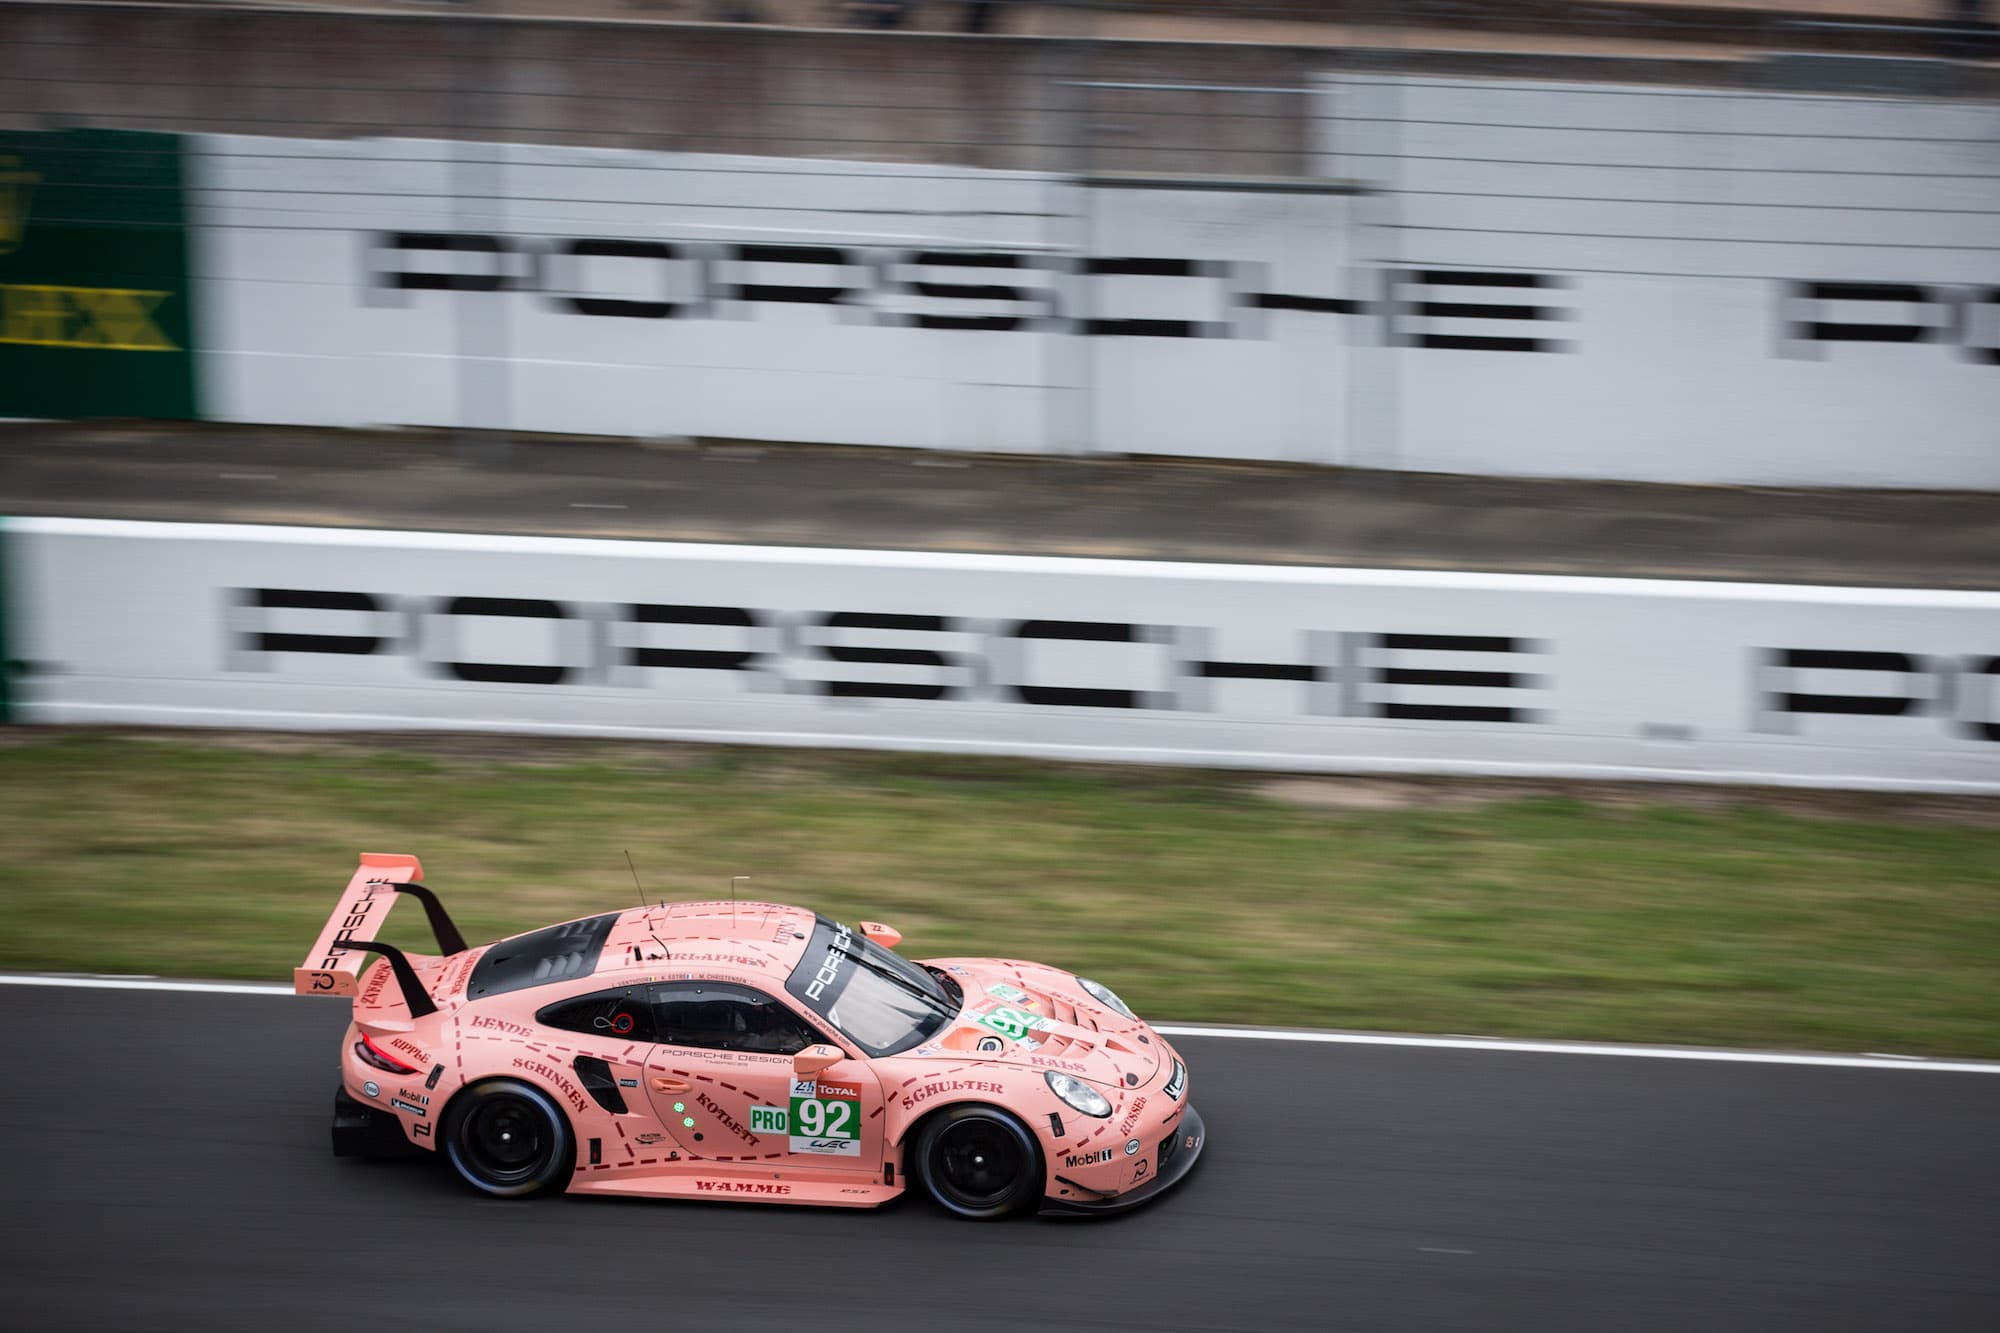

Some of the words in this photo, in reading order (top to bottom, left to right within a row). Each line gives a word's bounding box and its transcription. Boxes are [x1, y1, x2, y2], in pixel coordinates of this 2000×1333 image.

[358, 230, 1576, 353] PORSCHE
[220, 586, 1550, 723] PORSCHE
[470, 1016, 533, 1037] LENDE
[662, 1049, 733, 1060] PORSCHE
[738, 1055, 793, 1065] DESIGN
[400, 1088, 421, 1102] Mobil
[696, 1092, 760, 1147] KOTLETT
[752, 1110, 786, 1130] PRO
[799, 1099, 851, 1138] 92
[1066, 1151, 1100, 1168] Mobil
[695, 1181, 791, 1194] WAMME
